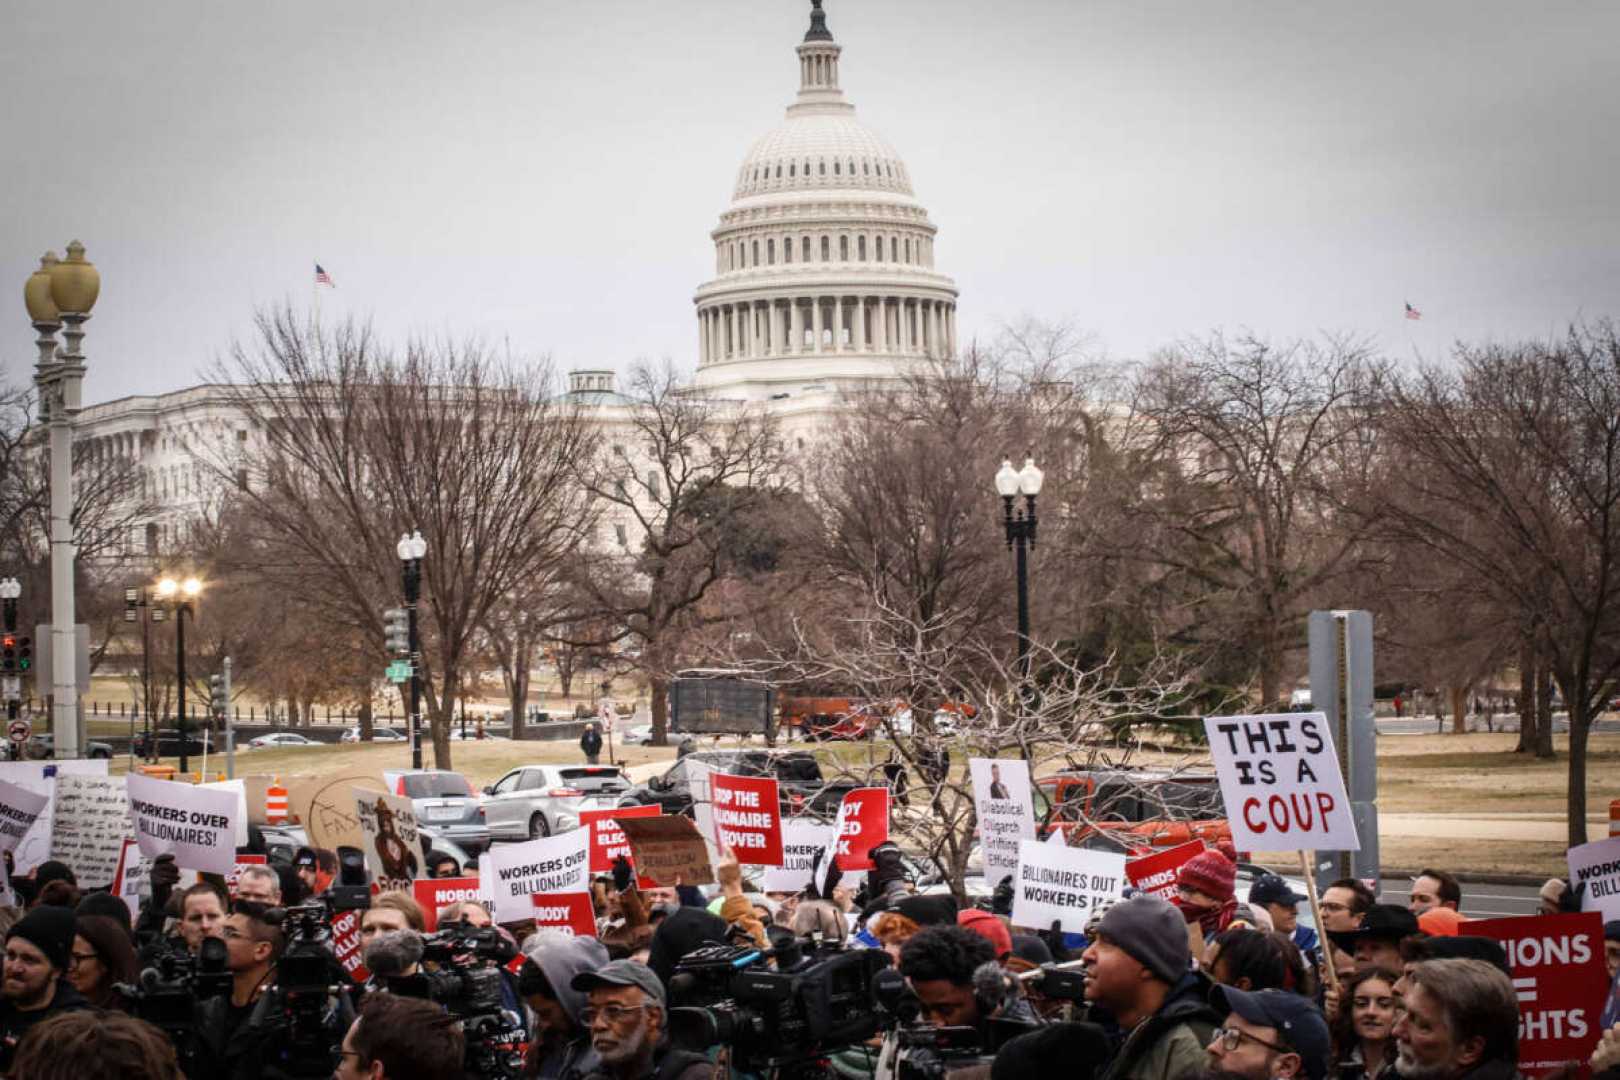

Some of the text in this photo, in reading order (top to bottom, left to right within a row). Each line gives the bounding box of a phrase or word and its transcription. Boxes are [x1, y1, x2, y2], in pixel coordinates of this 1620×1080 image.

[1217, 719, 1324, 756] THIS
[1234, 758, 1317, 786] IS A
[734, 790, 760, 807] THE
[1242, 791, 1335, 834] COUP
[131, 799, 188, 823] WORKERS
[190, 812, 229, 829] OVER
[138, 816, 217, 847] BILLIONAIRES!
[498, 850, 587, 881] WORKERS OVER
[1022, 864, 1118, 893] BILLIONAIRES OUT
[1136, 868, 1176, 892] HANDS
[1024, 886, 1088, 909] WORKERS
